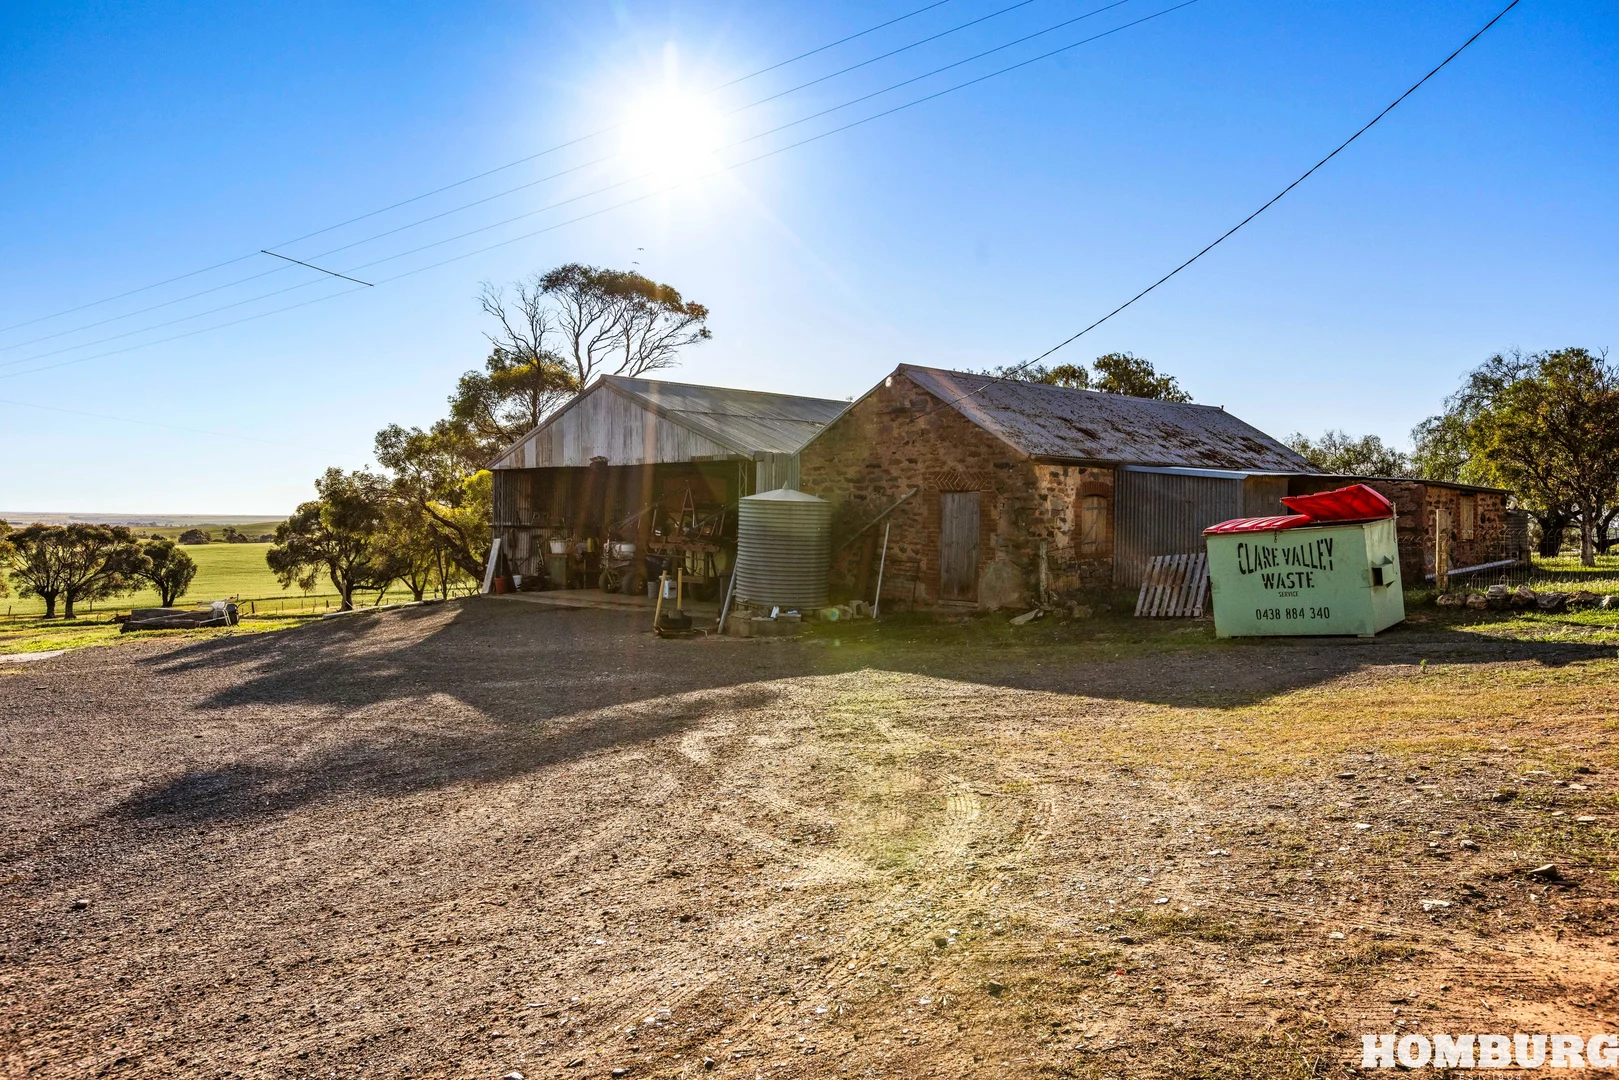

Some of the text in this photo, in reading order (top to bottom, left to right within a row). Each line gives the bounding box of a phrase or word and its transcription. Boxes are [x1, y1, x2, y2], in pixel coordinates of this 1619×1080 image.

[1237, 537, 1333, 575] CLARE VALLEY
[1261, 571, 1315, 590] WASTE
[1256, 606, 1330, 621] 0438 884 340
